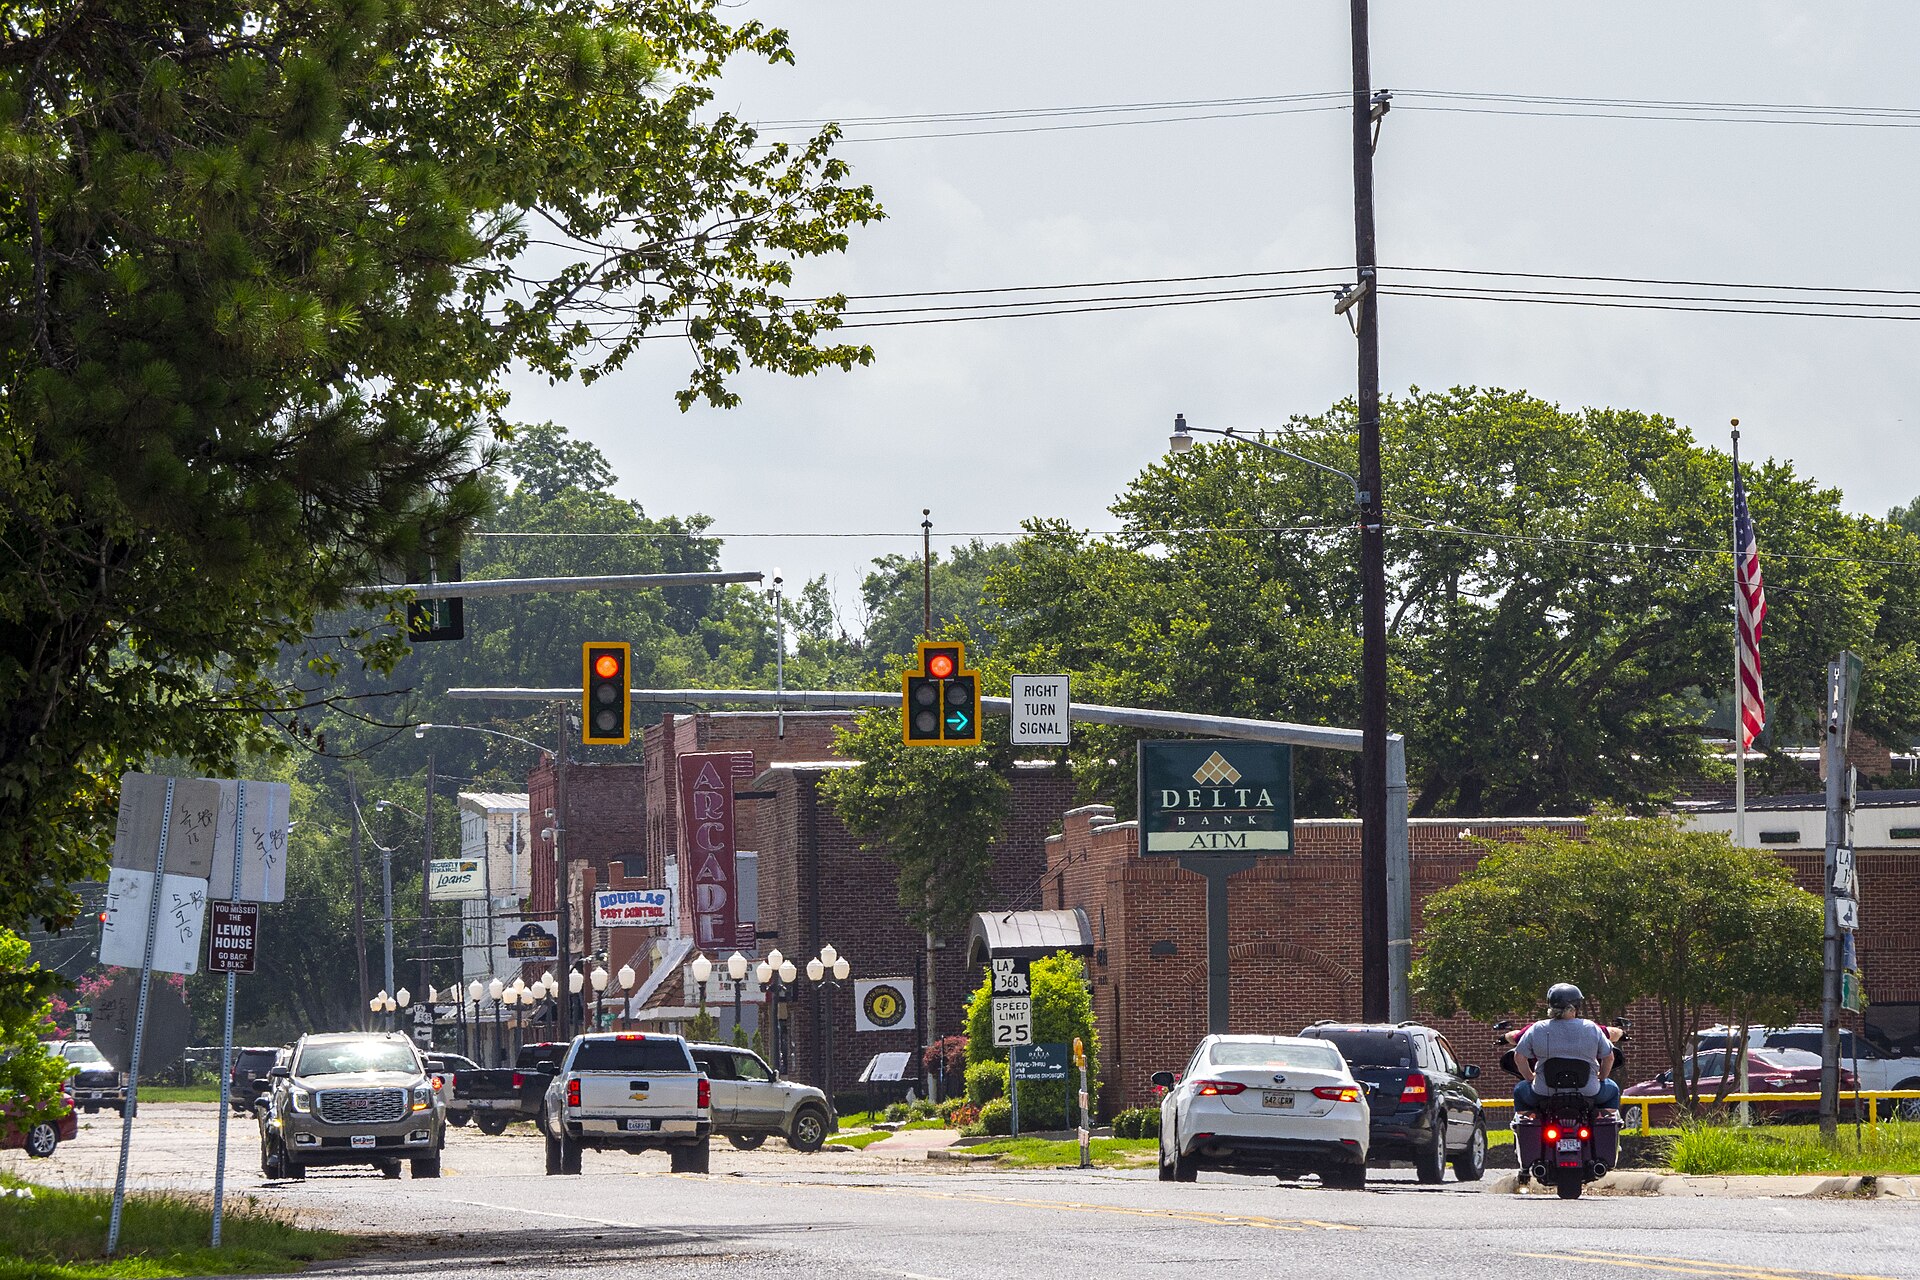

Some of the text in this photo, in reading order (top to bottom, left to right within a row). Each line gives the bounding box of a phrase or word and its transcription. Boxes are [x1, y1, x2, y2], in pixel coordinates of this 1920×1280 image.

[1024, 685, 1058, 697] RIGHT
[1024, 703, 1056, 716] TURN
[1019, 722, 1062, 735] SIGNAL
[1161, 788, 1274, 808] DELTA
[1177, 815, 1257, 825] BANK
[1188, 833, 1248, 849] ATM
[693, 760, 727, 943] ARCADE
[436, 874, 471, 889] Loans
[599, 892, 665, 908] DOUGLAS
[215, 905, 256, 914] YOU MISSED
[600, 906, 665, 919] PEST CONTROL
[217, 924, 252, 937] LEWIS
[215, 937, 253, 950] HOUSE
[218, 952, 248, 960] GO BACK
[220, 960, 225, 968] 3
[996, 960, 1009, 972] LA
[1001, 975, 1018, 988] 568
[996, 1002, 1028, 1011] SPEED
[999, 1012, 1025, 1021] LIMIT
[998, 1024, 1028, 1042] 25
